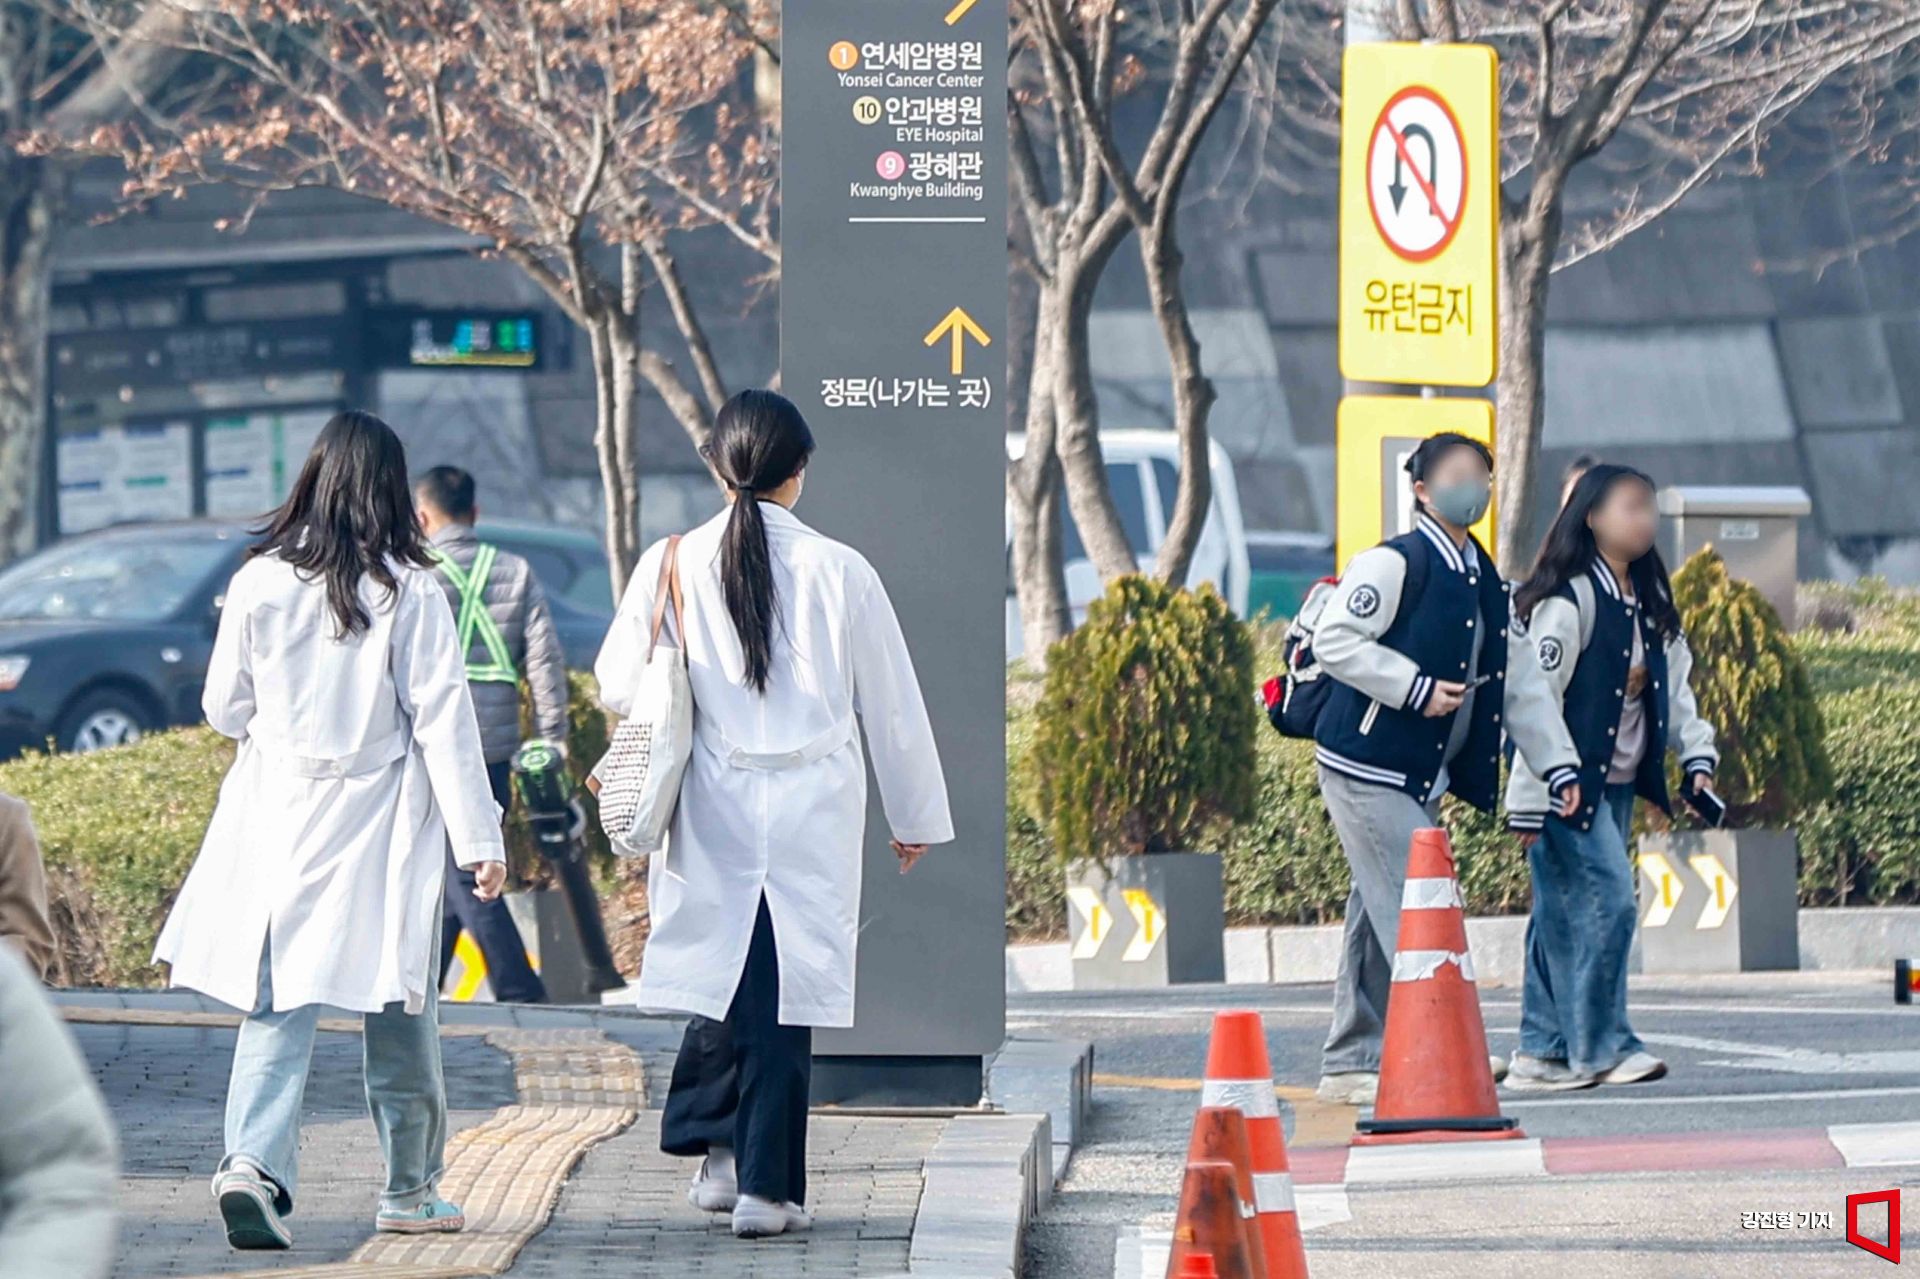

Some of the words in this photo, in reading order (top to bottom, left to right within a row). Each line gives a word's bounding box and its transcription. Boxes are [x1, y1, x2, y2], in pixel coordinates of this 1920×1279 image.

[861, 42, 983, 71] 연세암병원
[837, 72, 883, 88] Yonsei
[885, 72, 934, 88] Cancer
[936, 72, 984, 88] Center
[859, 102, 877, 119] 10
[885, 96, 983, 126] 안과병원
[896, 127, 923, 143] EYE
[925, 127, 984, 145] Hospital
[908, 151, 984, 181] 광혜관
[850, 182, 923, 200] Kwanghye
[925, 182, 984, 201] Building
[1363, 280, 1472, 336] 유턴금지
[820, 376, 951, 409] 정문(나가는
[957, 376, 992, 409] 곳)
